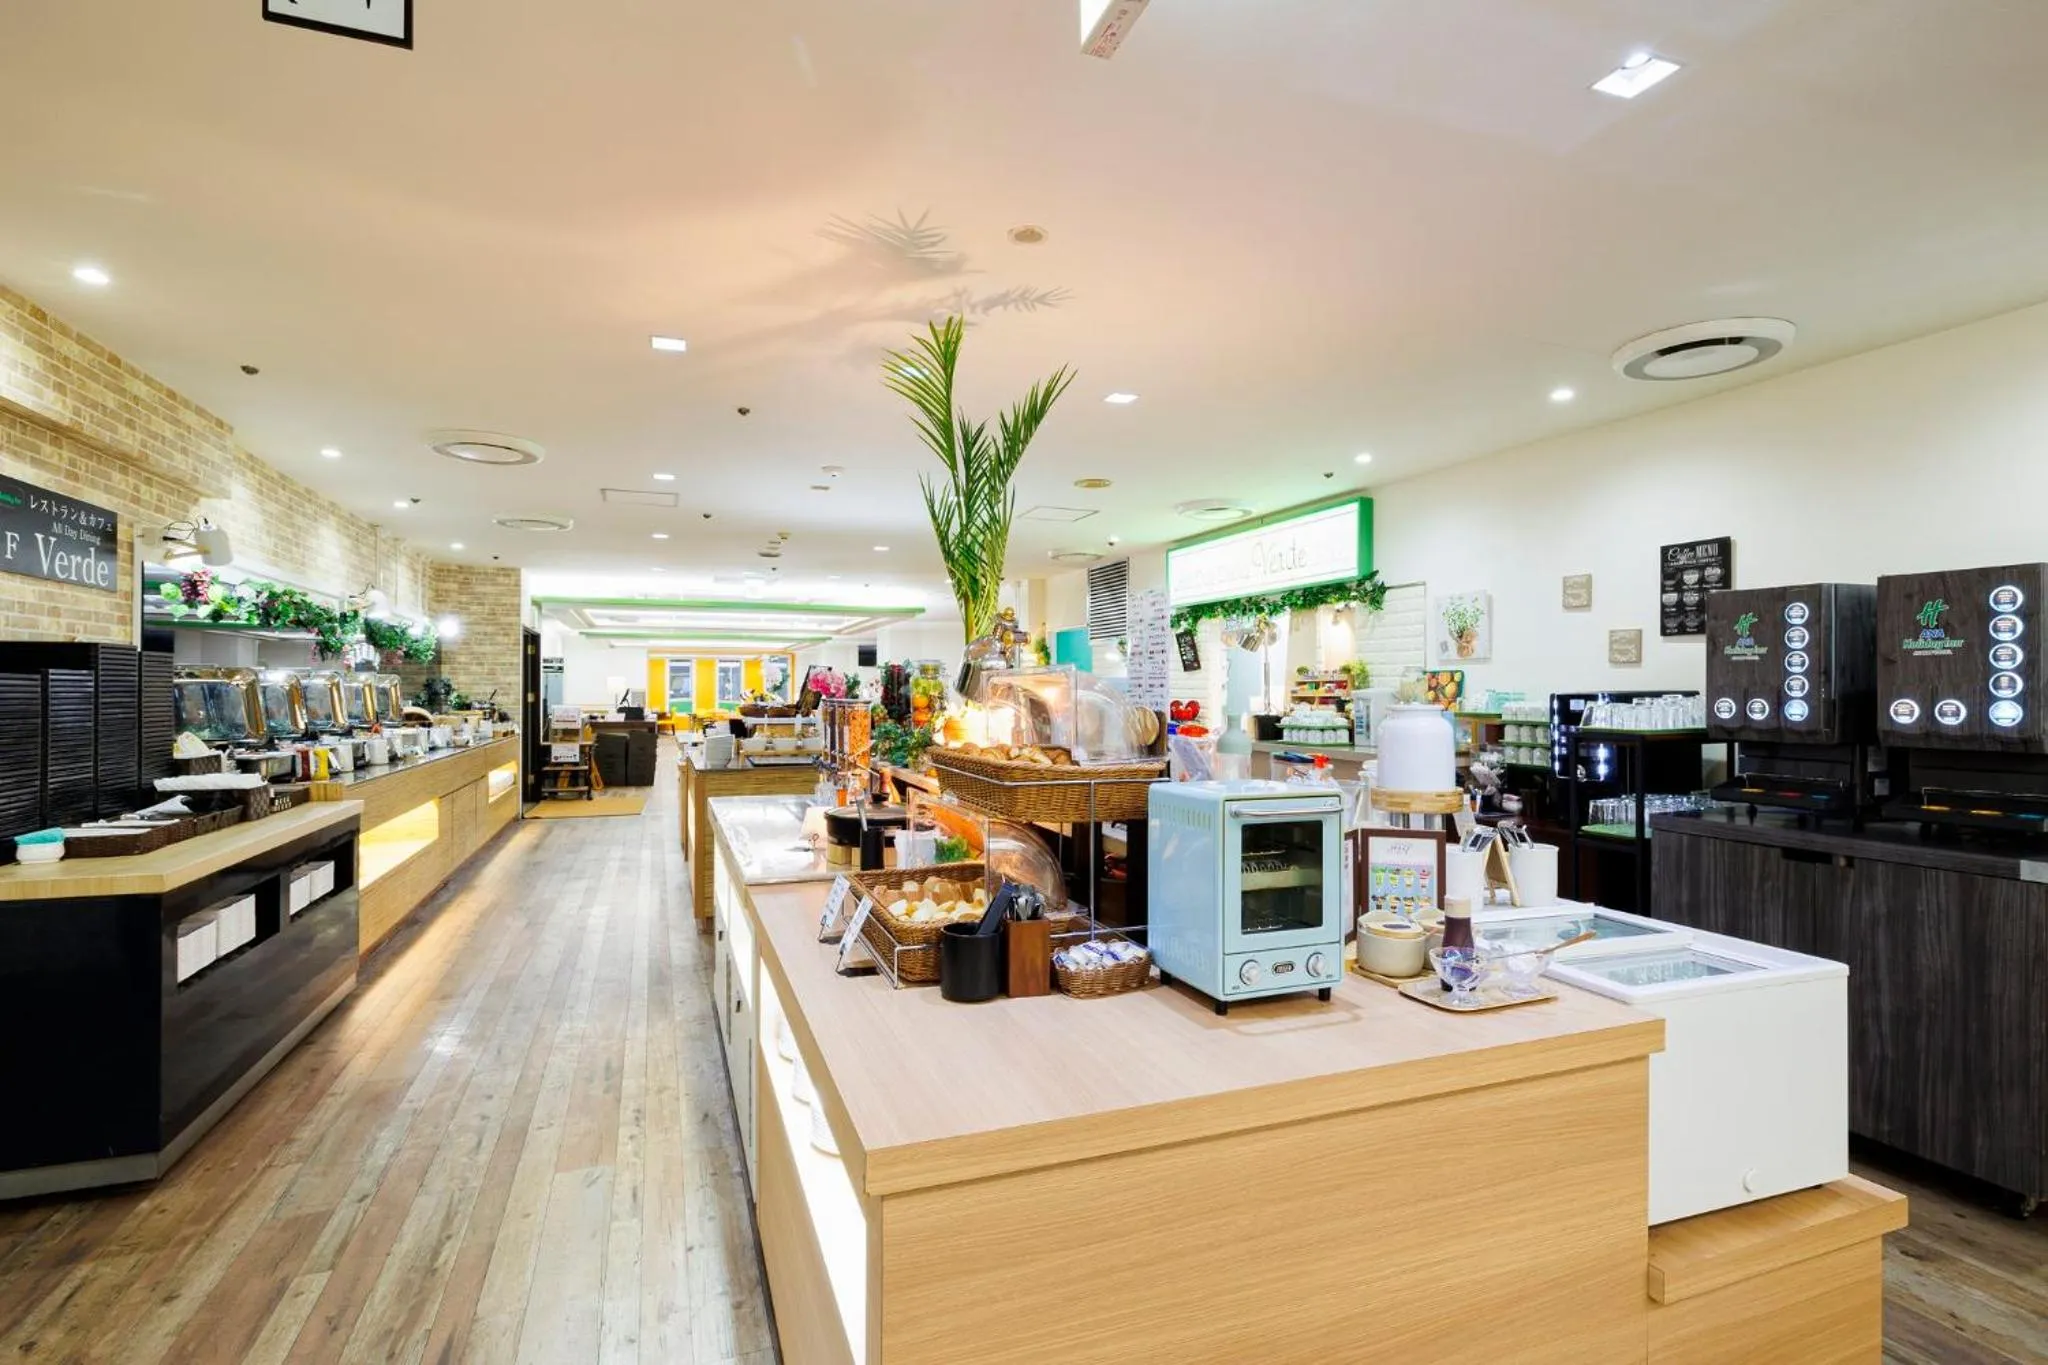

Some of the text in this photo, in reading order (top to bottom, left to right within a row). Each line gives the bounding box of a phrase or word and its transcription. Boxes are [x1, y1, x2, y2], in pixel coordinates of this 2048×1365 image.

[30, 495, 113, 532] レストラン&カフェ
[52, 521, 102, 546] All Day Dining
[34, 532, 109, 587] Verde
[1696, 543, 1719, 558] MENU
[1919, 628, 1945, 640] ANA
